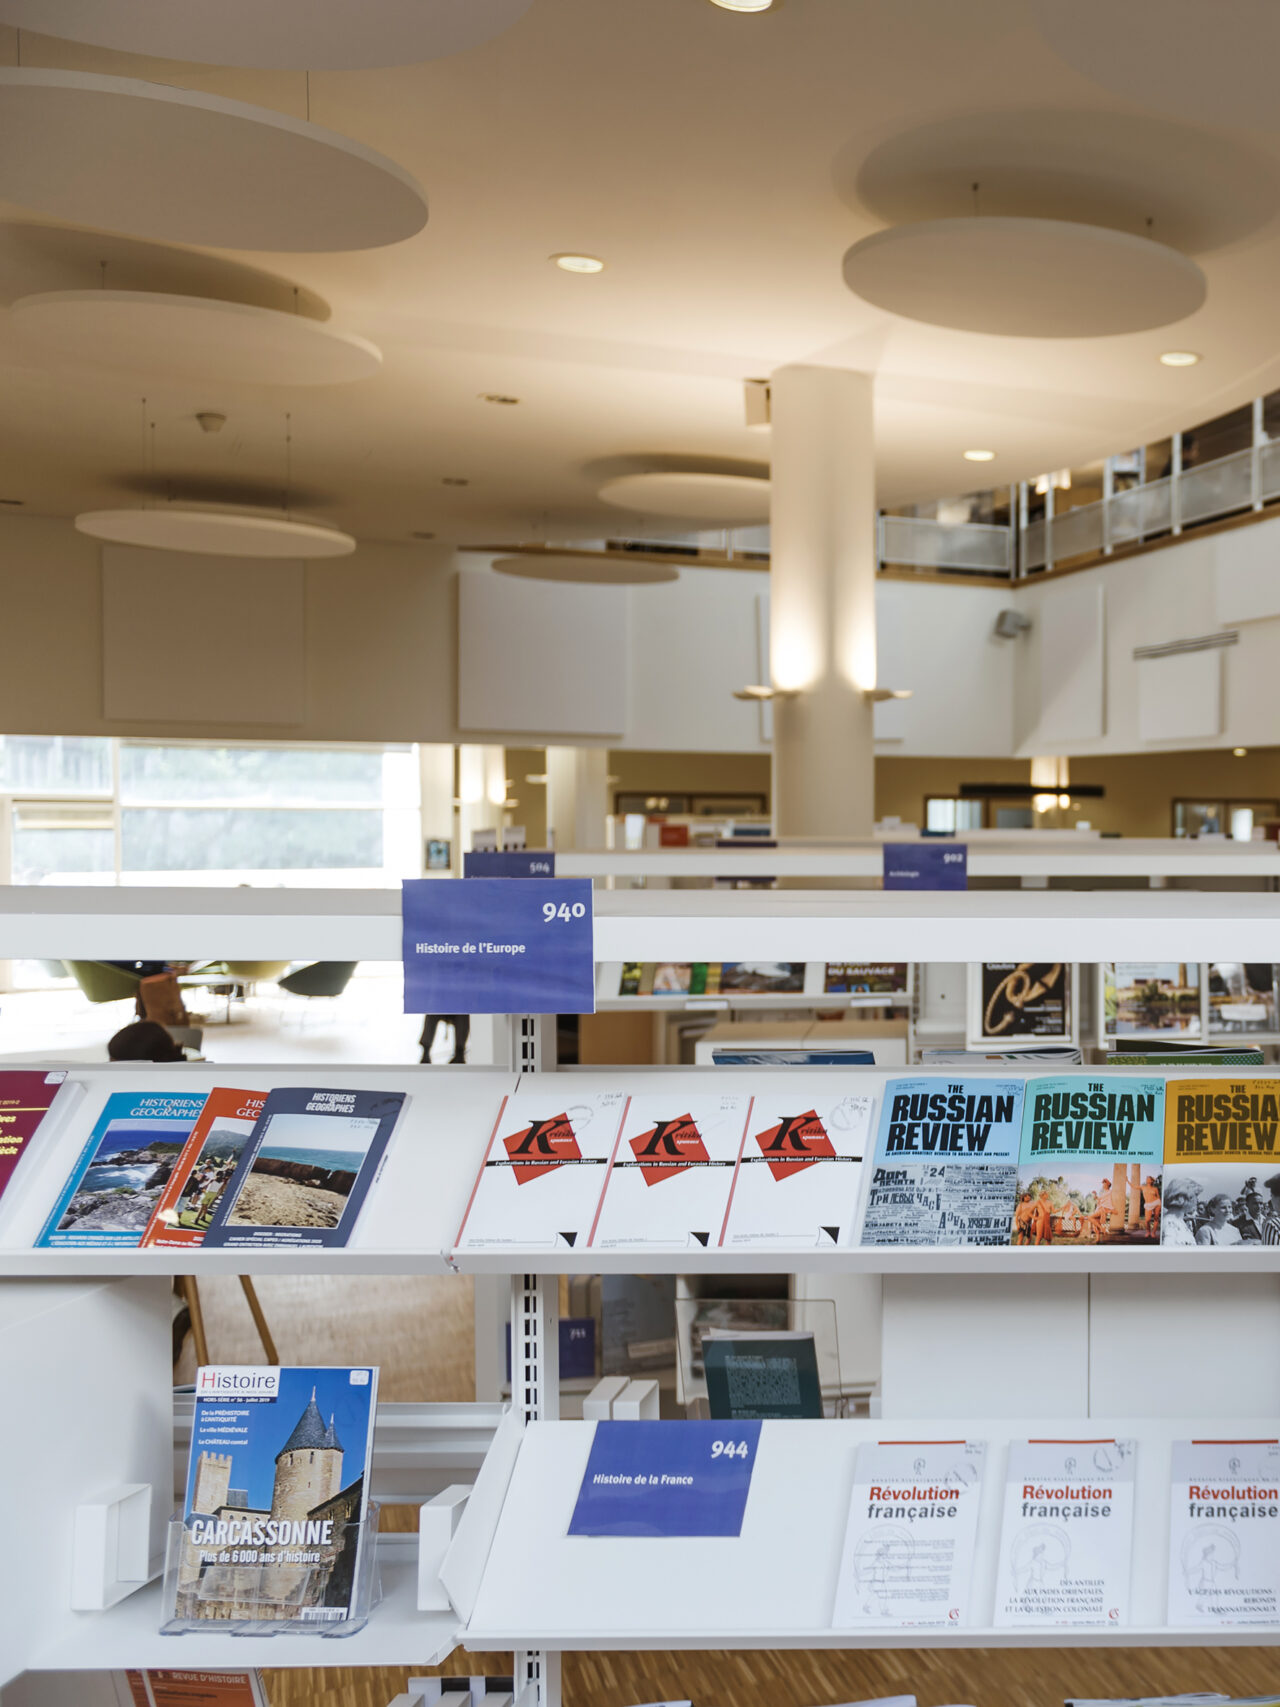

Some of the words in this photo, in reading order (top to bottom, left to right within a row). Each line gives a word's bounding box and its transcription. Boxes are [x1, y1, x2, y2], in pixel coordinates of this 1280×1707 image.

[543, 902, 586, 923] 940
[416, 943, 459, 954] Histoire
[462, 943, 476, 954] de
[479, 943, 526, 955] l'Europe
[948, 1085, 964, 1093] THE
[1088, 1083, 1104, 1092] THE
[1230, 1085, 1246, 1093] THE
[139, 1098, 204, 1108] HISTORIENS
[312, 1092, 357, 1103] HISTORIENS
[891, 1094, 1014, 1123] RUSSIAN
[1033, 1092, 1155, 1122] RUSSIAN
[886, 1122, 992, 1151] REVIEW
[1031, 1121, 1134, 1150] REVIEW
[1176, 1122, 1278, 1151] REVIEW
[201, 1372, 276, 1389] Histoire
[711, 1440, 748, 1459] 944
[593, 1473, 632, 1485] Histoire
[634, 1474, 646, 1485] de
[649, 1474, 659, 1485] la
[661, 1474, 693, 1485] France
[869, 1486, 960, 1501] Révolution
[1022, 1485, 1112, 1500] Révolution
[1189, 1485, 1278, 1500] Révolution
[868, 1503, 957, 1523] française
[1022, 1502, 1111, 1522] française
[1189, 1502, 1278, 1523] française
[191, 1519, 334, 1546] CARCASSONNE
[200, 1550, 218, 1563] Plus
[219, 1550, 230, 1562] de
[259, 1552, 275, 1562] ans
[277, 1550, 320, 1563] d'histoire
[172, 1672, 199, 1681] REVUE
[200, 1673, 247, 1684] D'HISTOIRE
